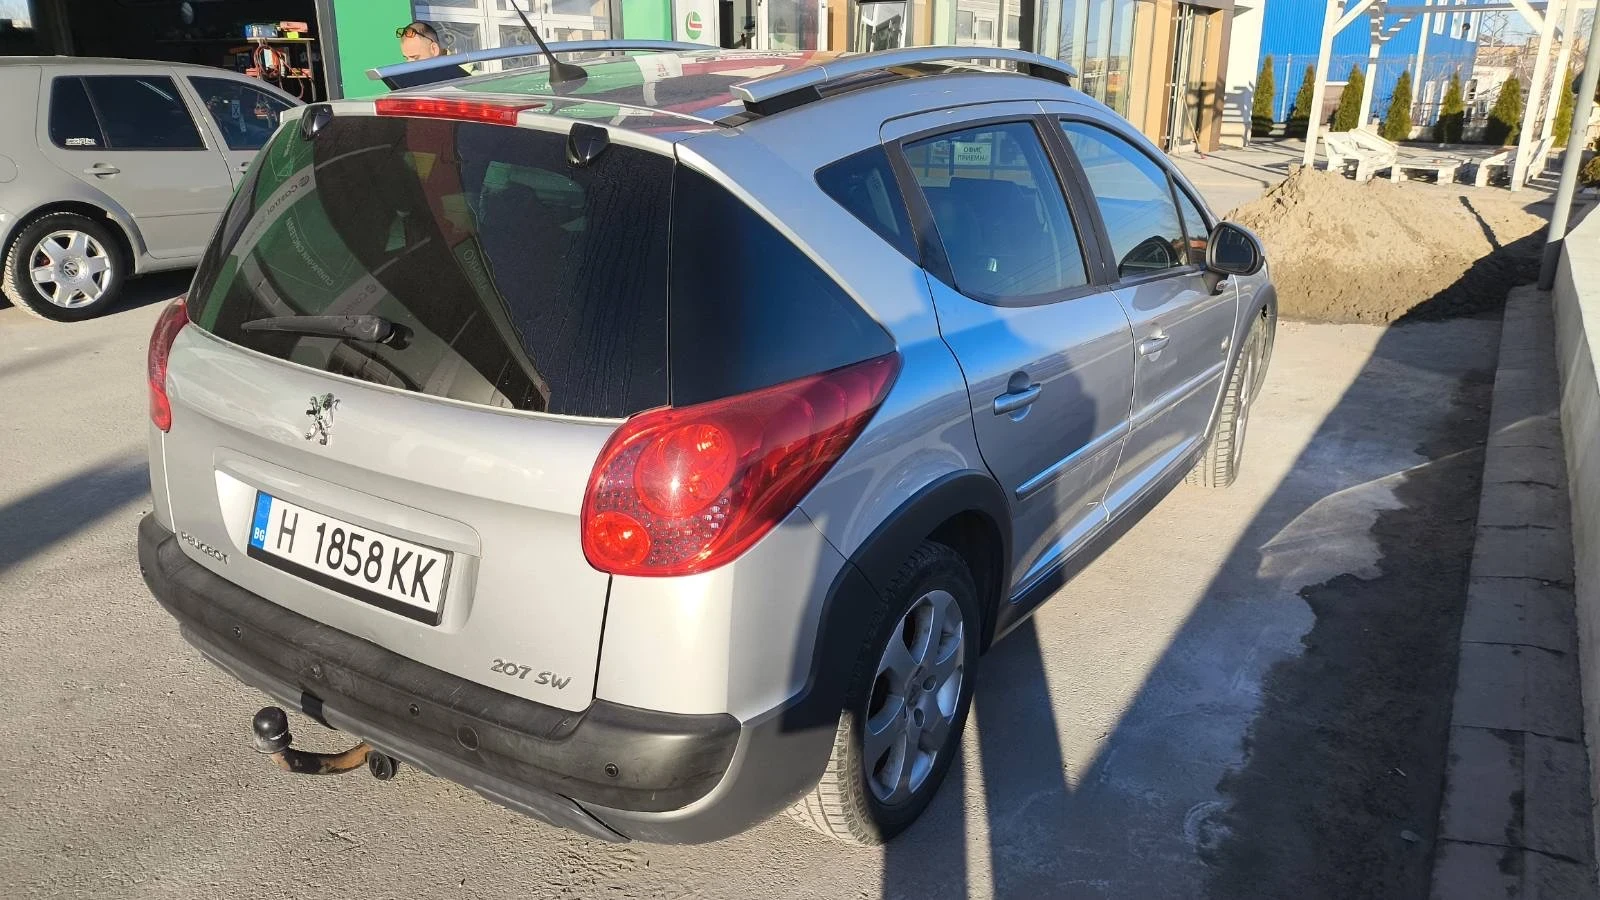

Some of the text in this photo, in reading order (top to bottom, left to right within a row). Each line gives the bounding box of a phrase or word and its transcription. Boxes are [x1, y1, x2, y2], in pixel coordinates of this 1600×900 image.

[180, 530, 229, 565] PEUGEOT
[253, 527, 265, 542] BG
[276, 508, 299, 554] H
[490, 658, 572, 690] 207 SW
